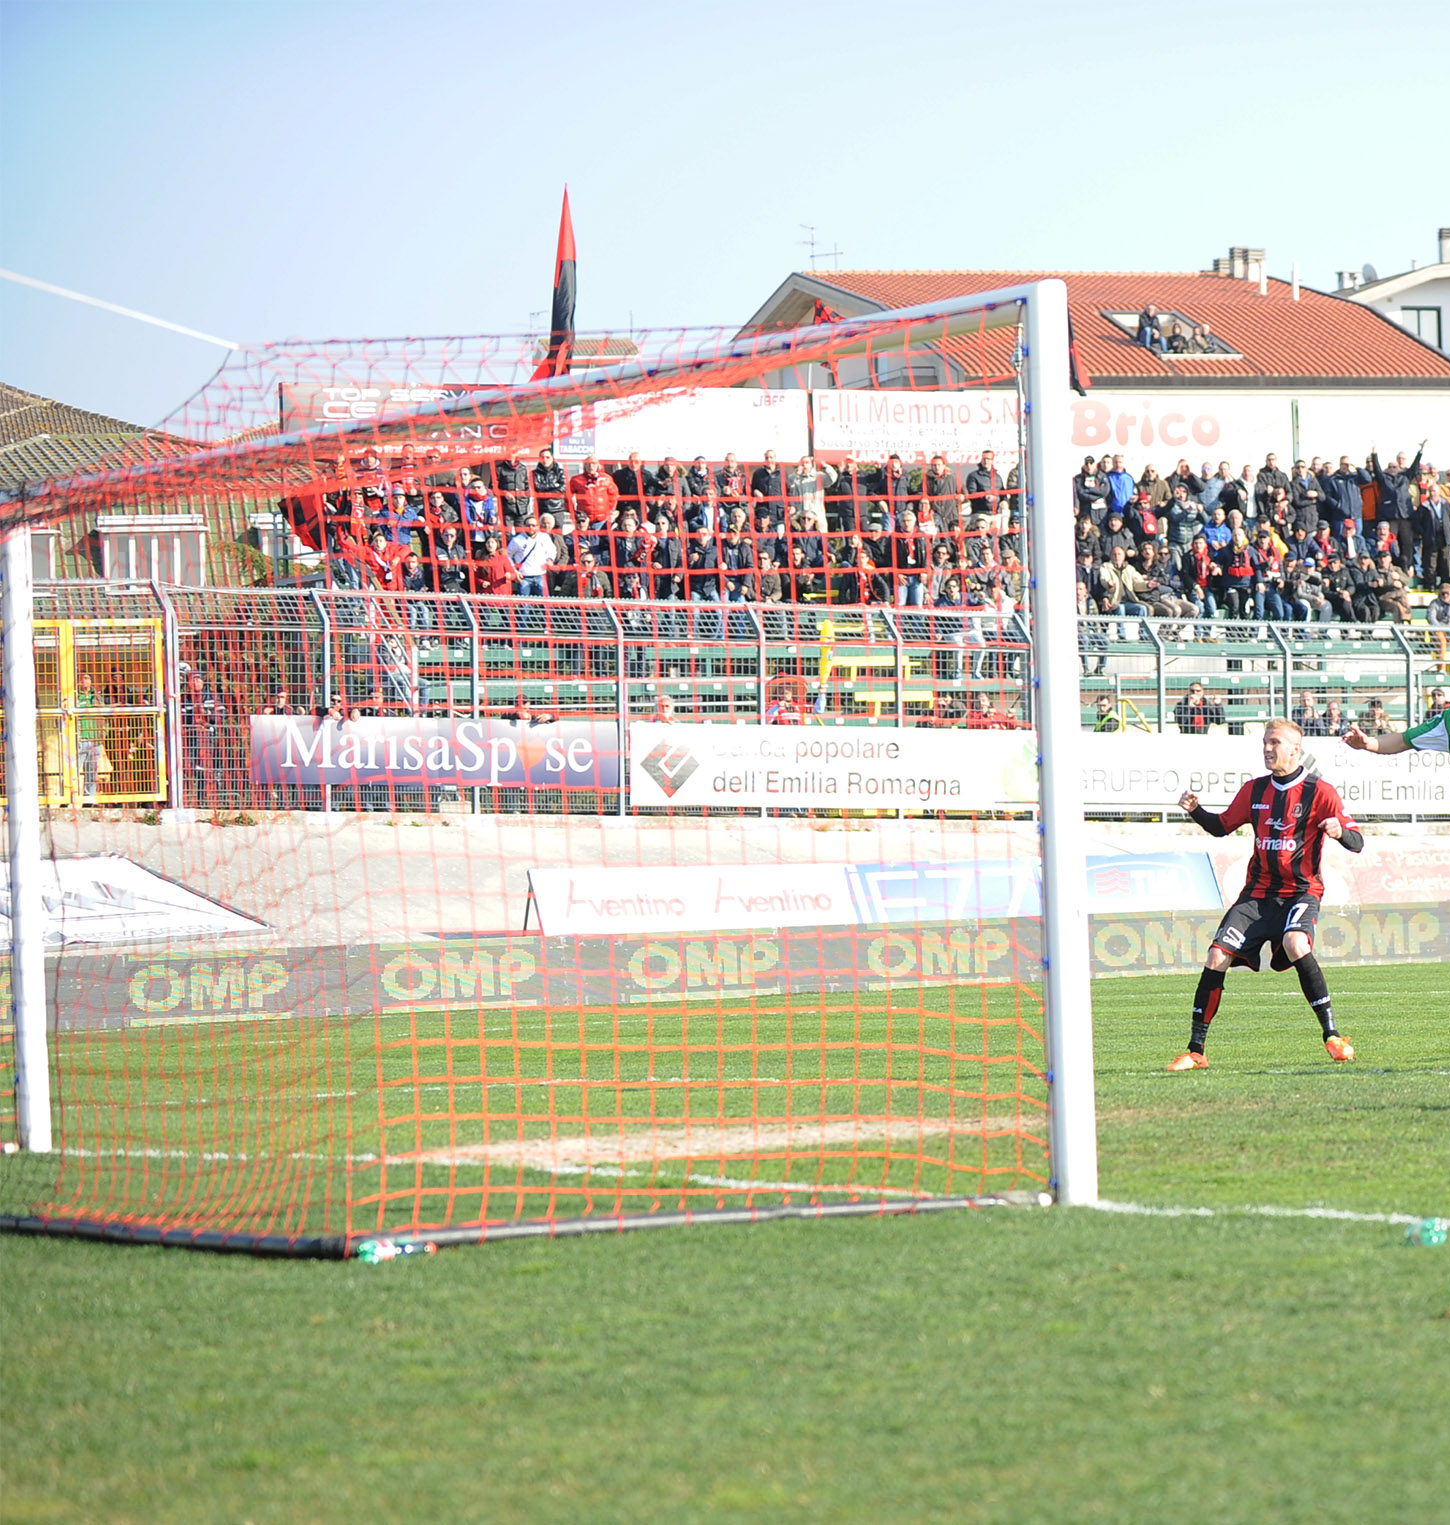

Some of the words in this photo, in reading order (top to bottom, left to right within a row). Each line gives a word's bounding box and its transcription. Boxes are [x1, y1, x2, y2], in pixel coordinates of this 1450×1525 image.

[322, 388, 381, 402] TOP
[869, 395, 971, 424] Memmo
[1071, 400, 1220, 447] Brico
[280, 717, 594, 787] MarisaSpse
[794, 737, 900, 764] popolare
[847, 771, 962, 802] Romagna
[380, 949, 536, 1001] OMP
[627, 938, 780, 989] OMP
[866, 928, 1010, 978] OMP
[129, 960, 289, 1012] OMP
